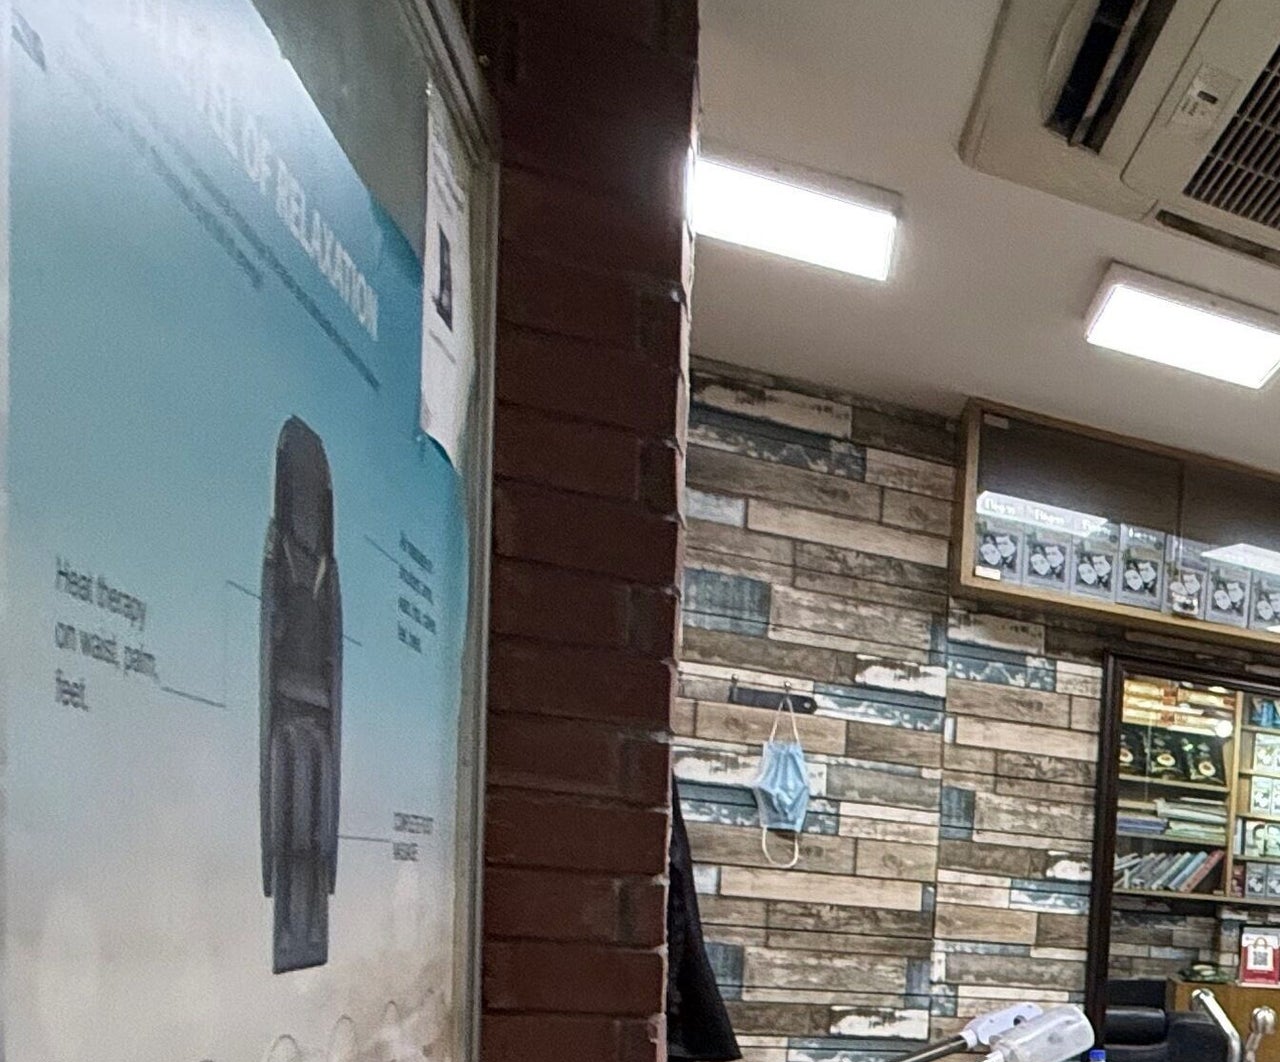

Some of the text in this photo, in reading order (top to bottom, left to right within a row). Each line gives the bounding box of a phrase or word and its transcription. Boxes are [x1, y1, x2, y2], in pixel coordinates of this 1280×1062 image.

[273, 154, 379, 343] RELAXATION
[55, 556, 148, 632] Heat therapy
